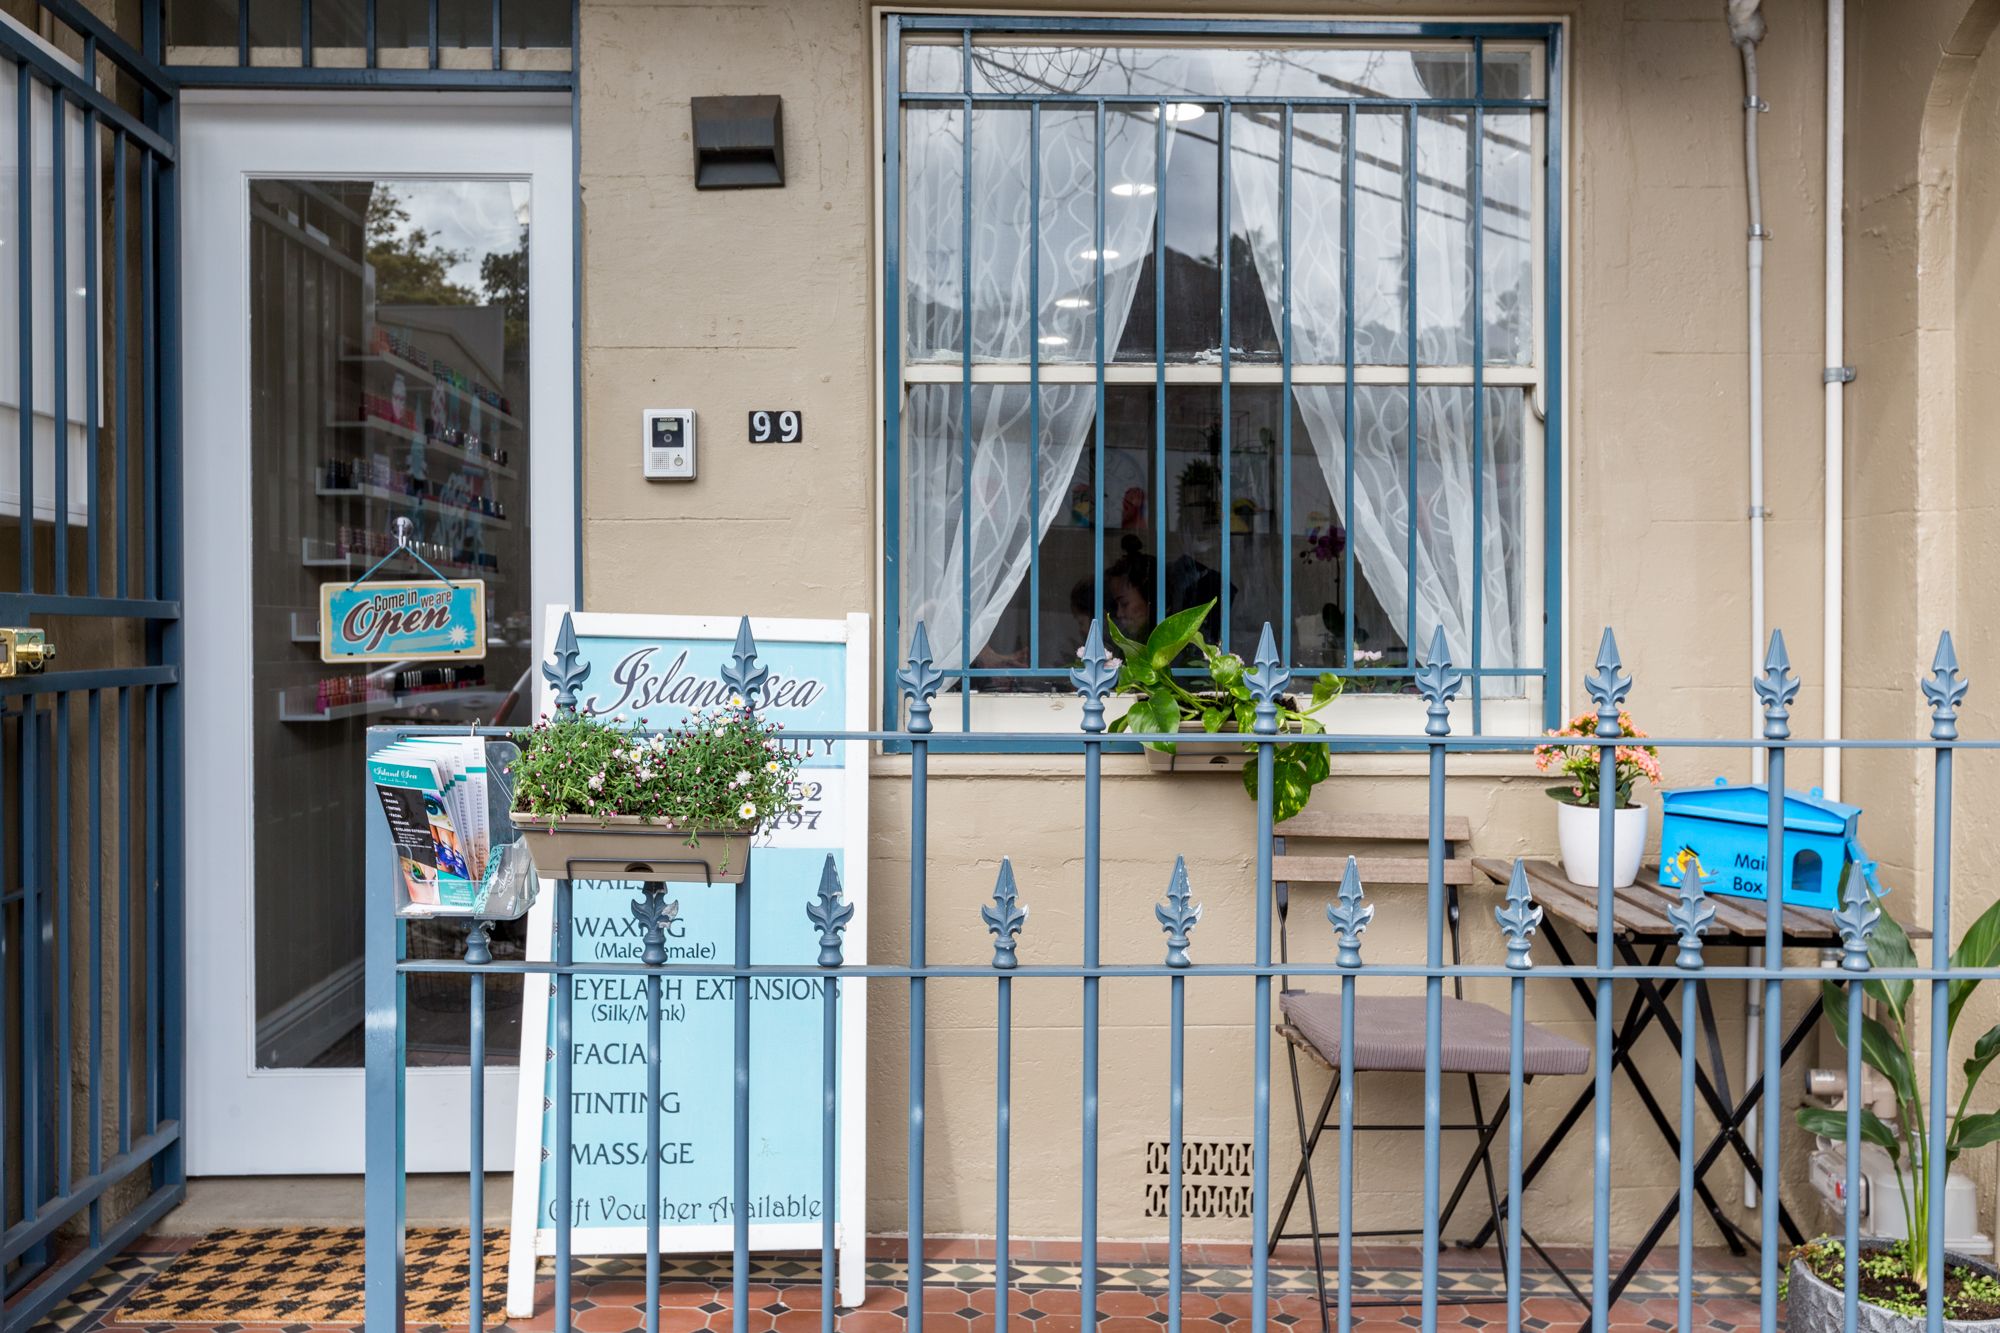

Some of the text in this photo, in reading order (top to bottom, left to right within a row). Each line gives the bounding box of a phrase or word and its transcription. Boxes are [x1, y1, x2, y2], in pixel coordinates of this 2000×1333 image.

[752, 411, 799, 442] 99
[374, 590, 452, 612] Come in we are
[343, 600, 450, 651] Open
[1734, 853, 1767, 871] Mai
[577, 879, 645, 890] NAIL
[1733, 876, 1763, 894] Box
[574, 917, 686, 937] WAXG
[574, 978, 841, 1000] EYELAH EXTNSION
[591, 1003, 686, 1024] (Silk/Mnk)
[573, 1043, 661, 1065] FACIA
[571, 1142, 694, 1165] MASSGE
[600, 1195, 702, 1222] Vouher
[708, 1194, 822, 1222] Aailable
